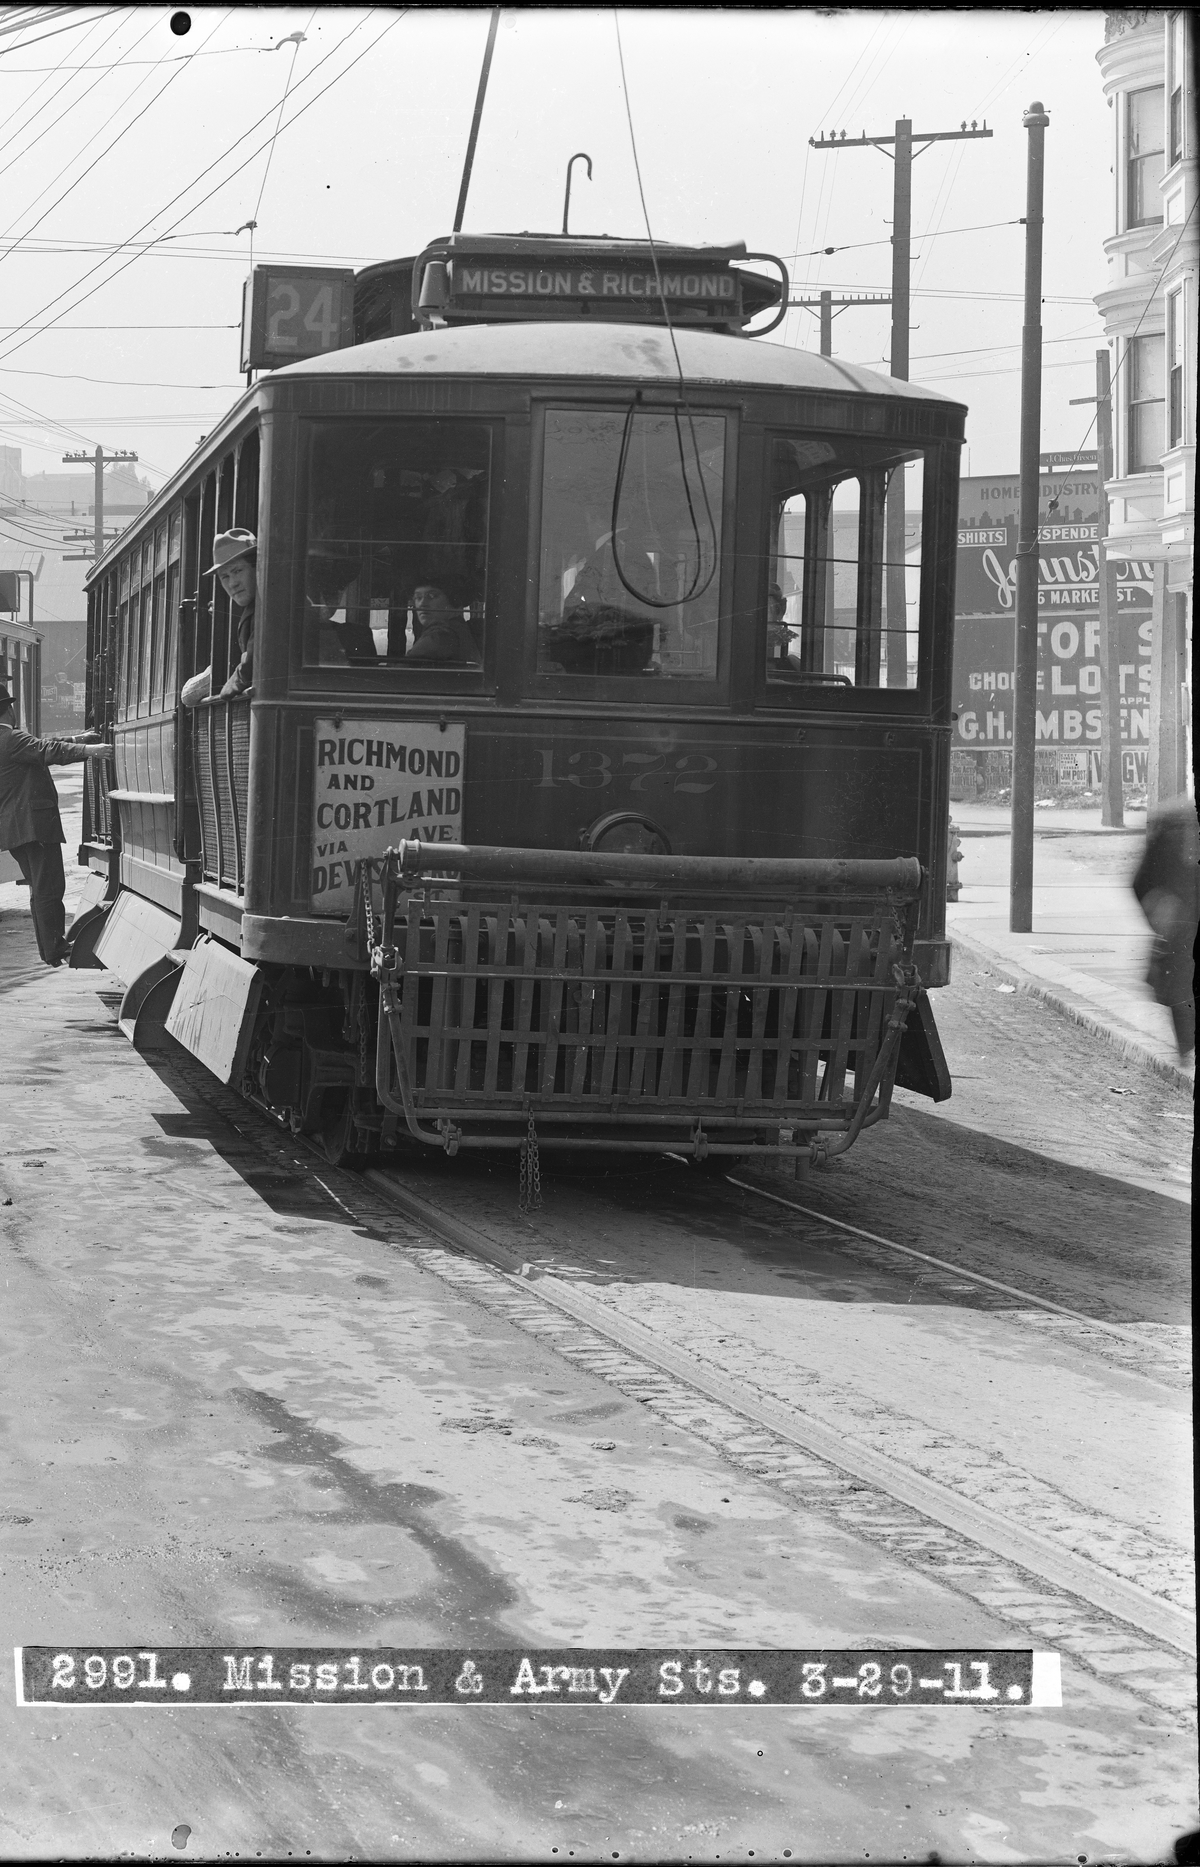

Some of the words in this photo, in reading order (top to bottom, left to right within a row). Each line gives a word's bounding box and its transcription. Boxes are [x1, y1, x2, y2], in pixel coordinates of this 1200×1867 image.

[462, 270, 574, 294] MISSION
[577, 272, 598, 295] &
[603, 273, 734, 299] RICHMOND
[269, 284, 338, 348] 24
[981, 486, 1020, 500] HOME
[958, 531, 1004, 544] SHIRTS
[1051, 589, 1099, 605] MARKE
[1119, 697, 1150, 705] APPL
[958, 710, 1013, 741] G.H.
[317, 738, 461, 778] RICHMOND
[533, 749, 719, 794] 1372
[1072, 769, 1086, 781] POST
[327, 773, 375, 792] AND
[316, 787, 461, 831] CORTLAND
[409, 824, 459, 843] AVE.
[317, 840, 348, 858] VIA
